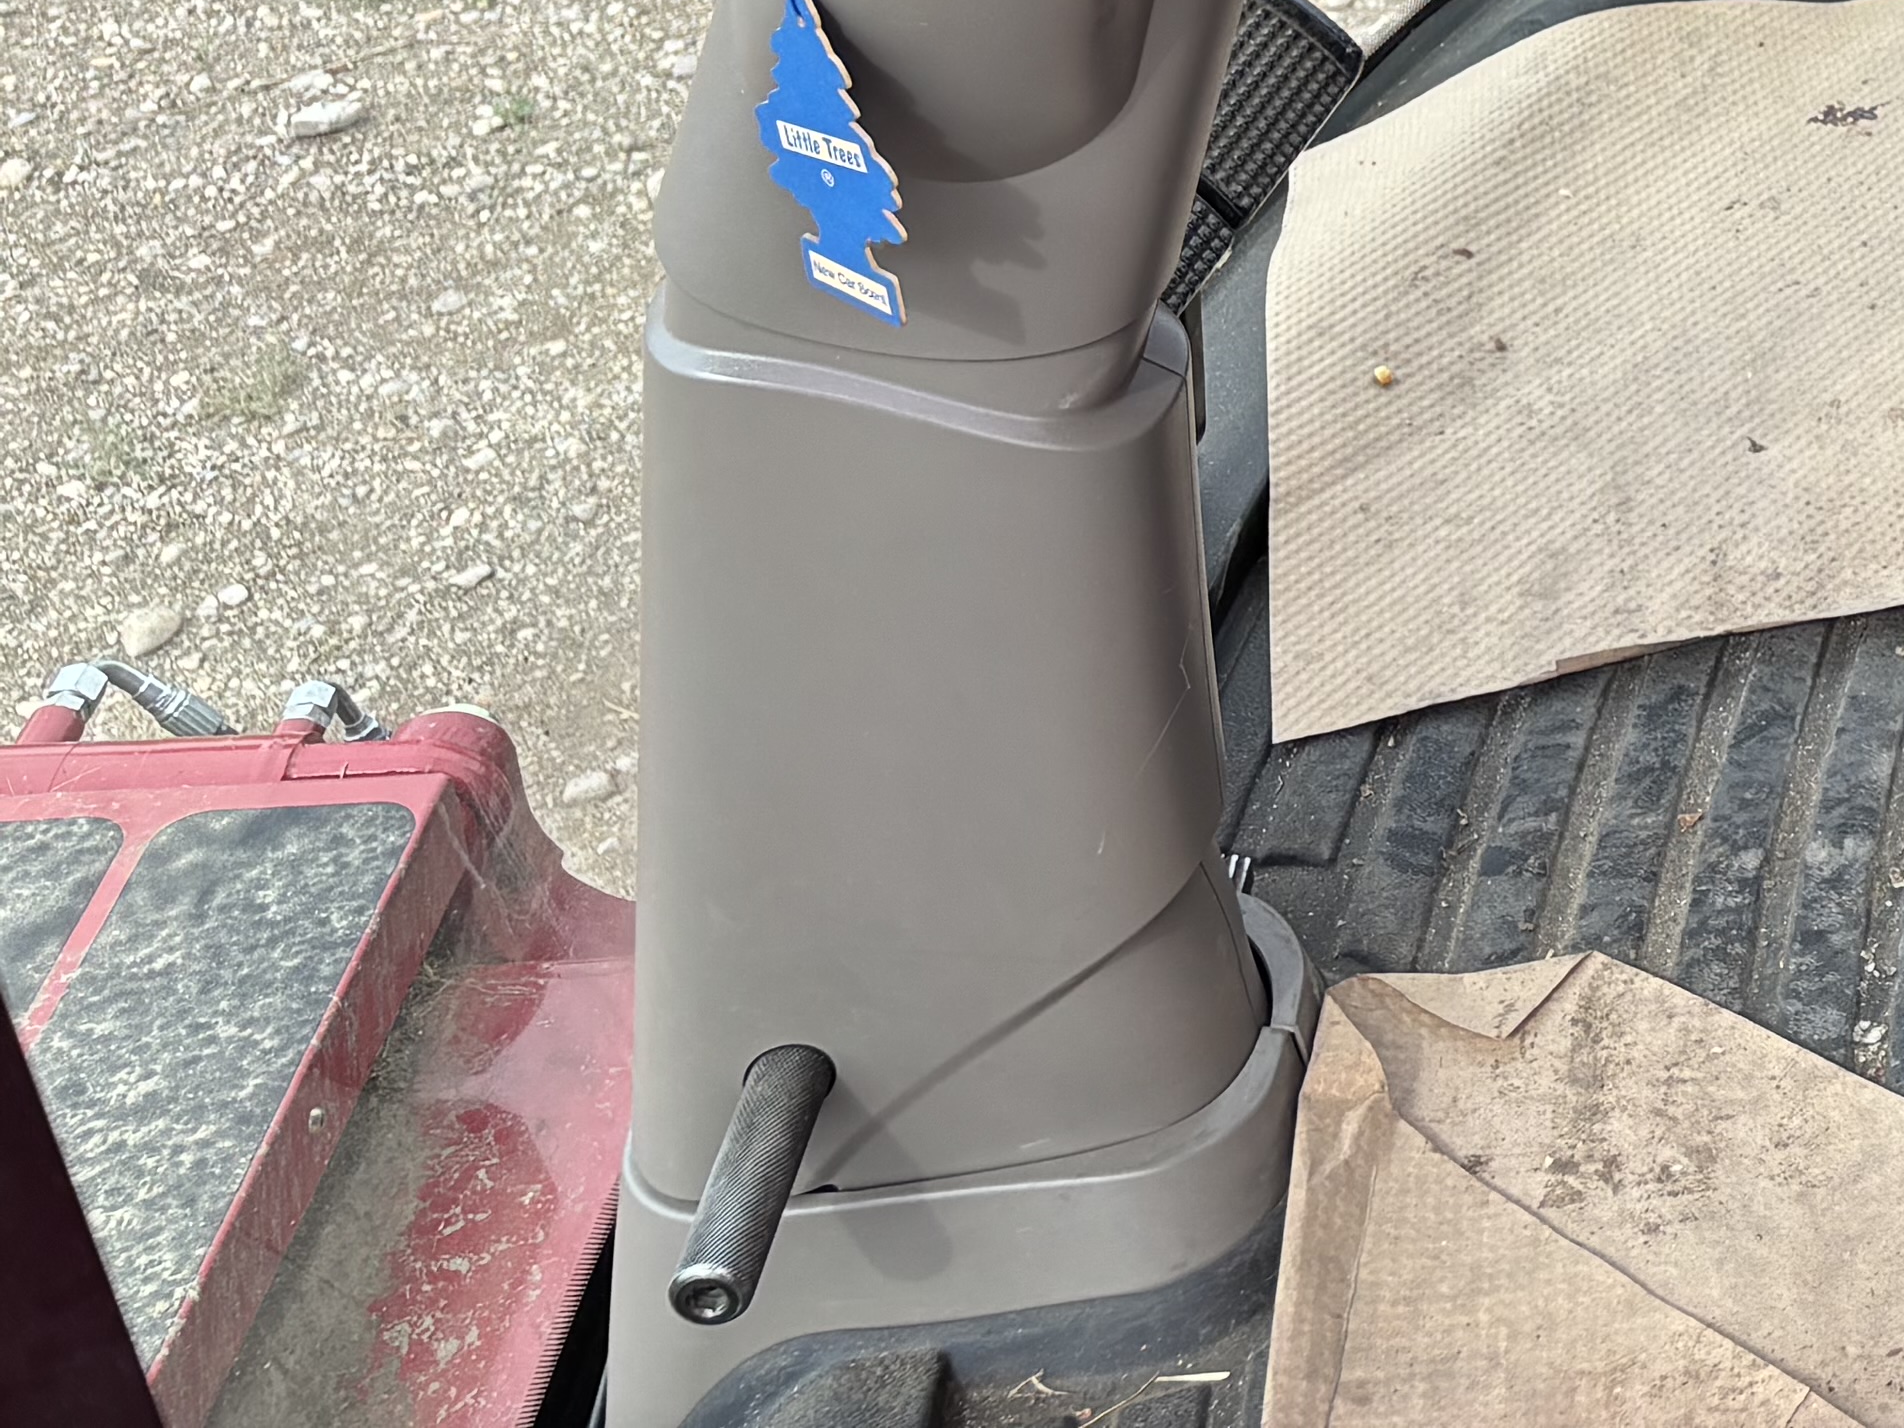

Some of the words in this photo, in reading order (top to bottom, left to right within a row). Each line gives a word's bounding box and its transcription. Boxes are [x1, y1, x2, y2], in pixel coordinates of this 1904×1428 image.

[783, 125, 821, 155] Little
[822, 137, 862, 168] Trees
[813, 260, 835, 279] New
[838, 272, 856, 290] Car
